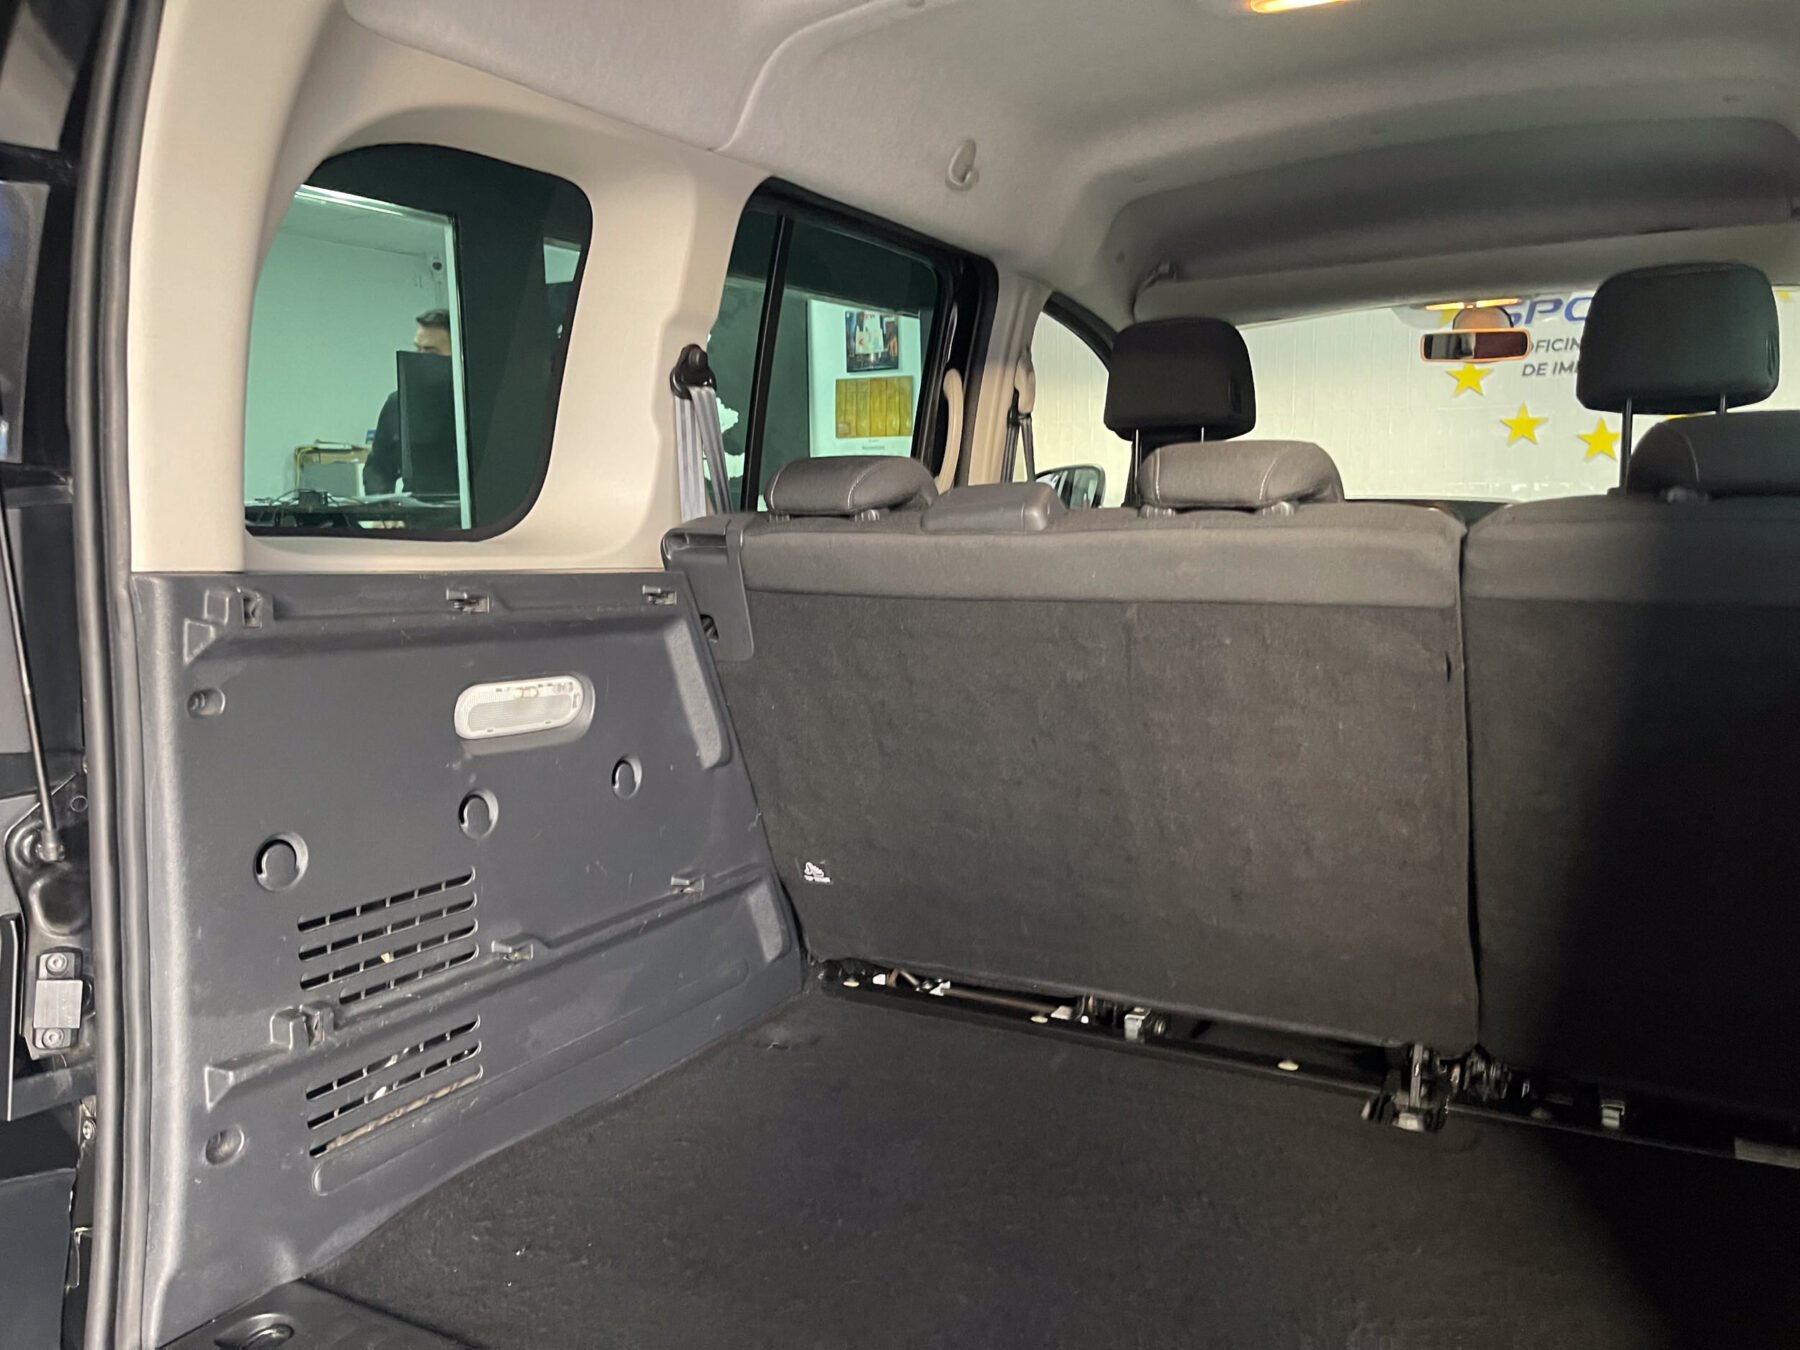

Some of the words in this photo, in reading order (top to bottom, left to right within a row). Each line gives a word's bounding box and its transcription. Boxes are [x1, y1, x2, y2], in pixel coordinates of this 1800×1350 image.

[1531, 336, 1581, 352] FICIN
[1521, 362, 1548, 377] DE
[1552, 360, 1579, 375] IM
